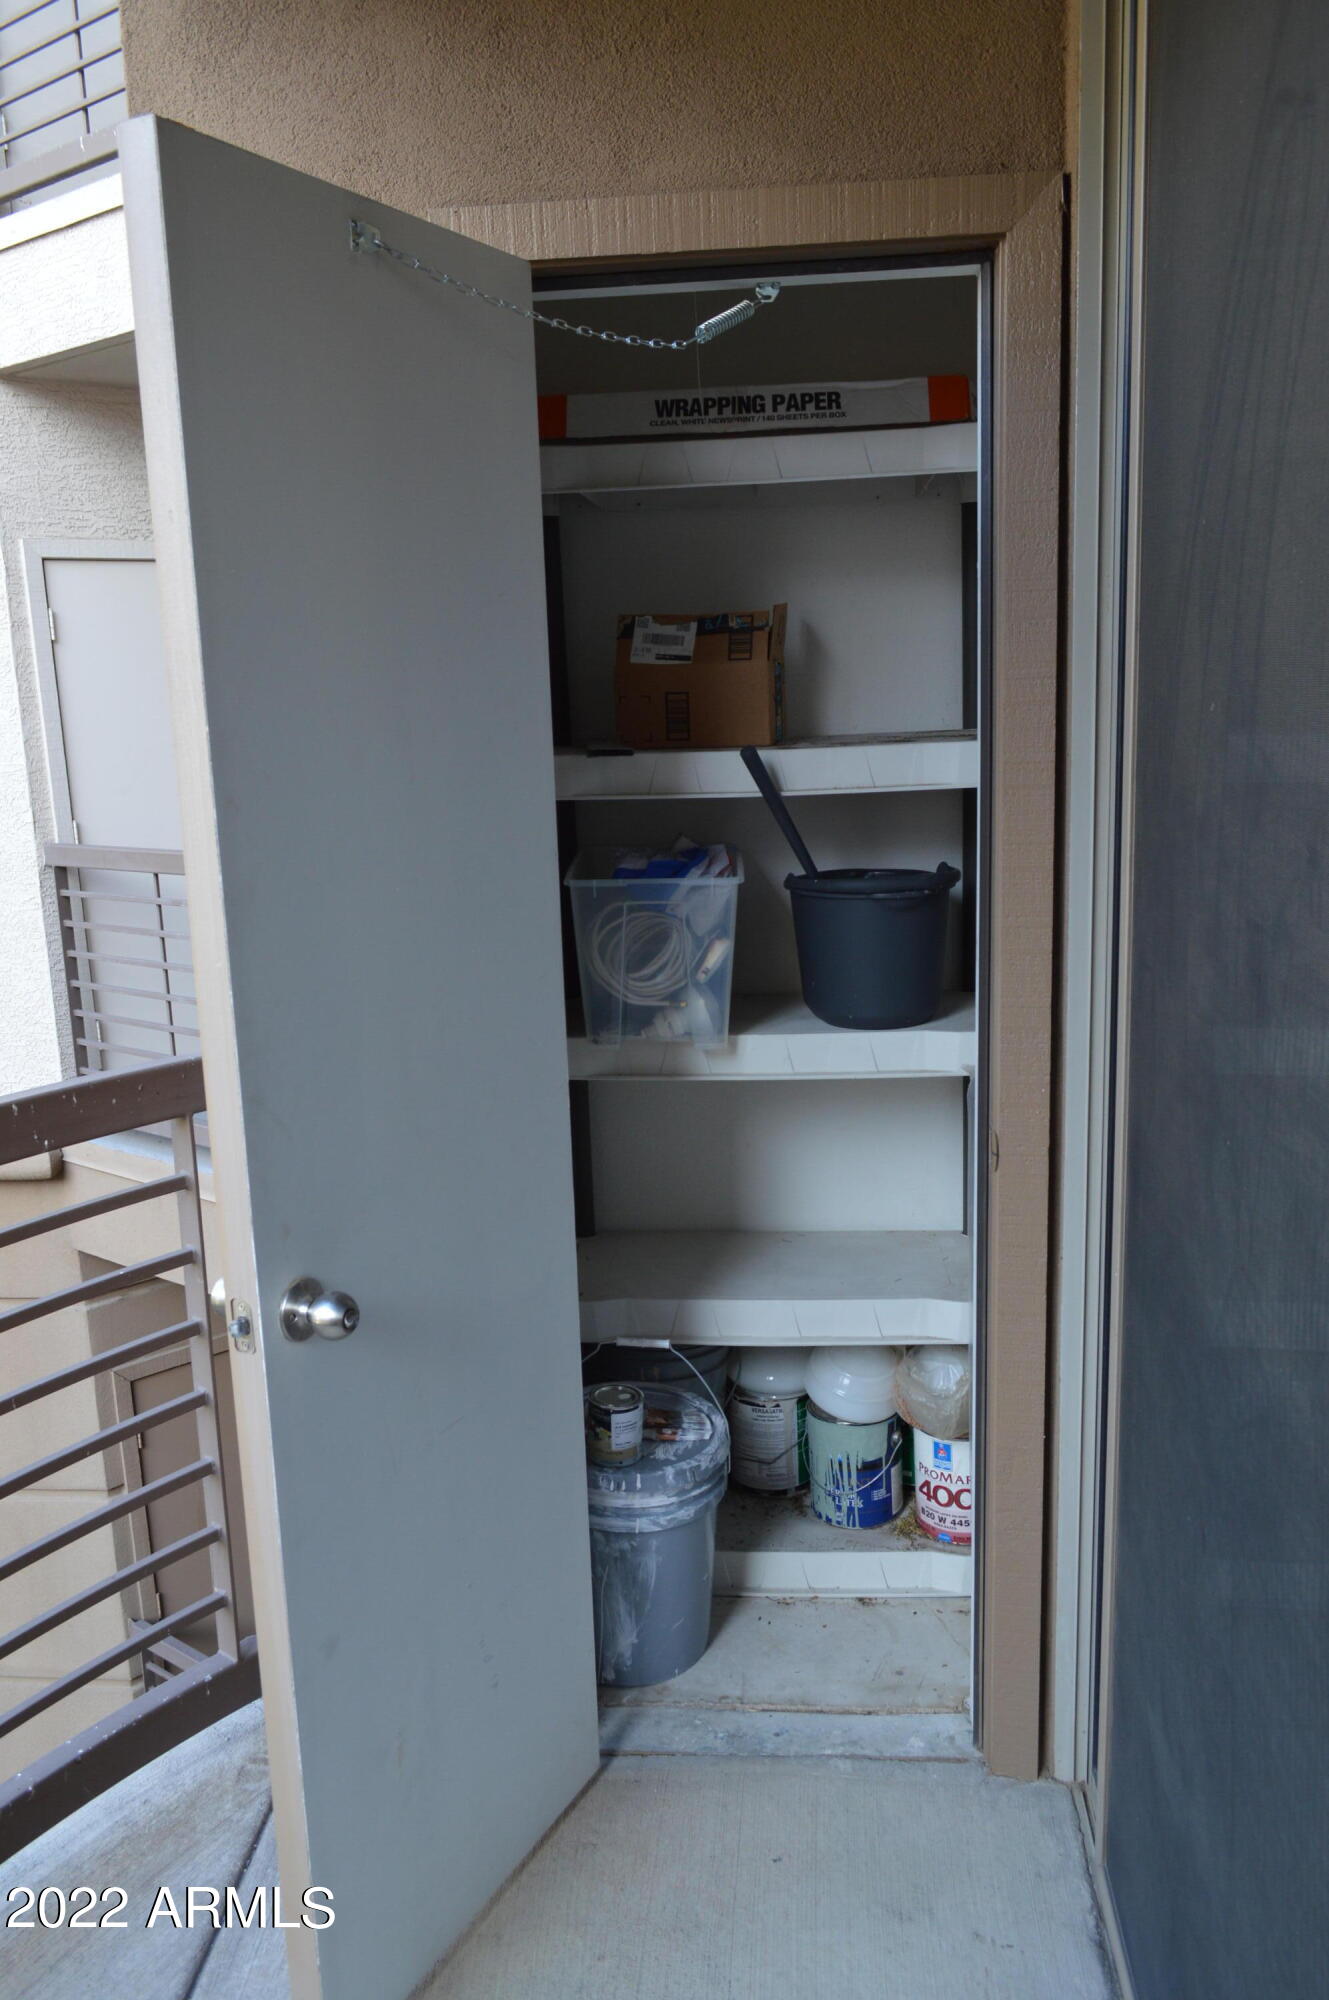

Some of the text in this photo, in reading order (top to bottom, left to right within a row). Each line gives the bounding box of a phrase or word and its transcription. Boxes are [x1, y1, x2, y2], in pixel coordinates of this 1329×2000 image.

[655, 391, 842, 417] WRAPPING PAPER
[681, 417, 705, 425] WHITE
[708, 415, 756, 424] NEWSPRINT
[777, 413, 809, 421] SHEETS
[937, 1515, 947, 1525] W
